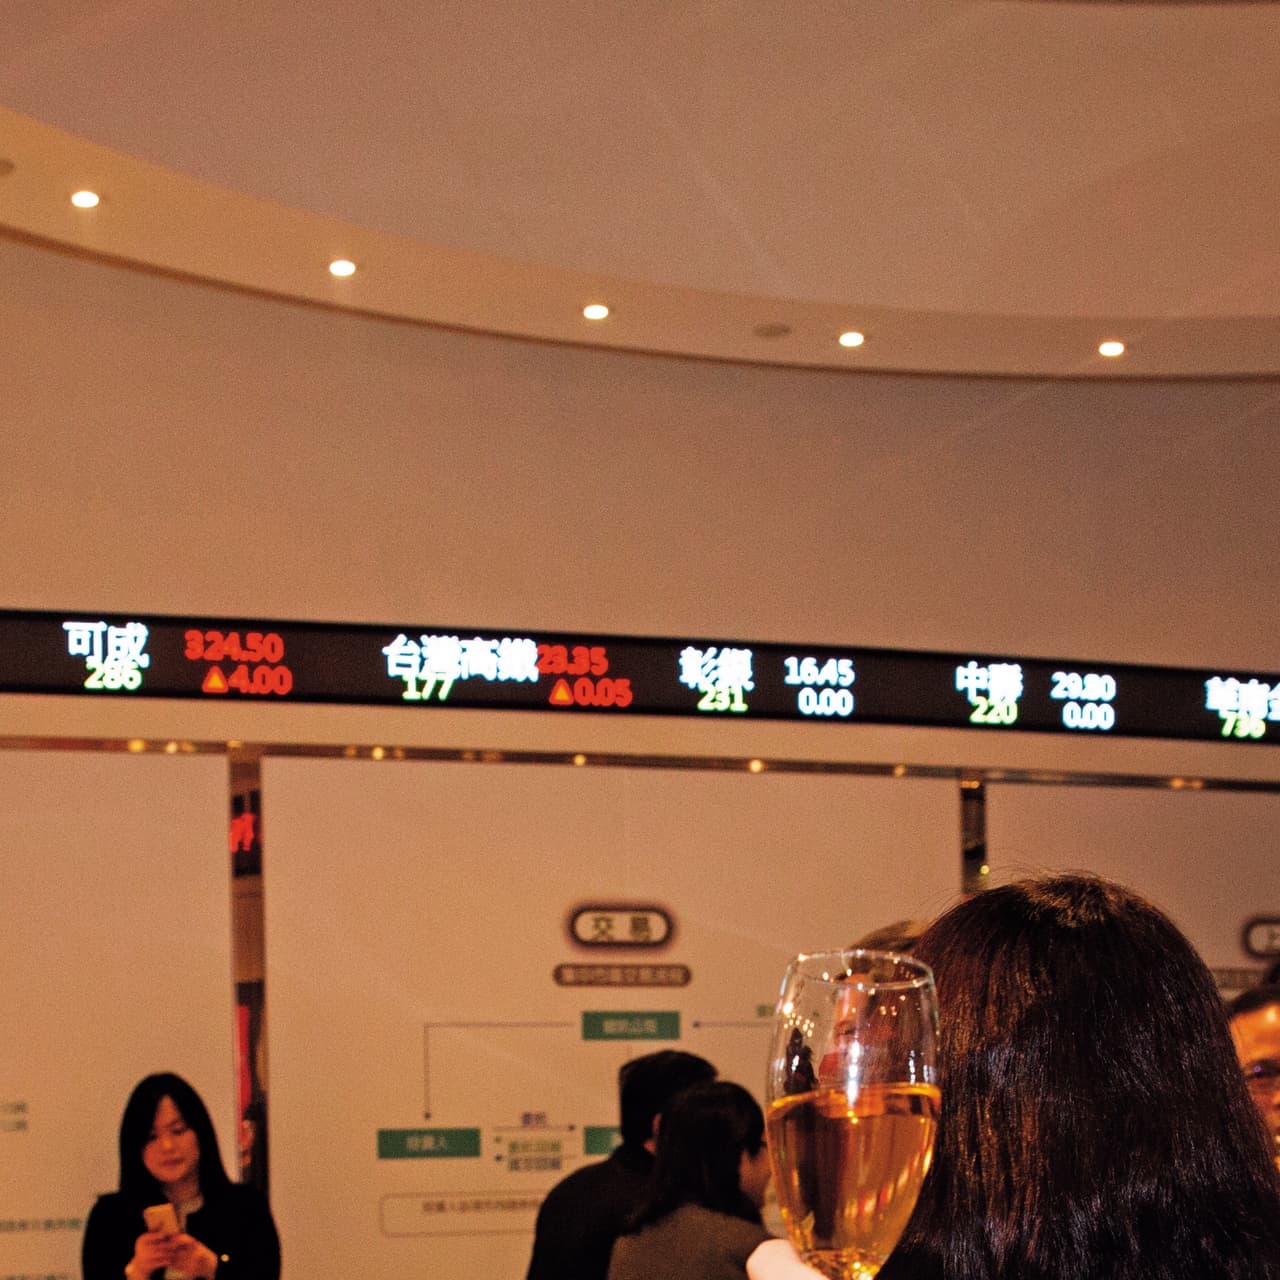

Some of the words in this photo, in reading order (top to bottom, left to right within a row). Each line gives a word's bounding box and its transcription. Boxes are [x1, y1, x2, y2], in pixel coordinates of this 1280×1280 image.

[184, 629, 284, 663] 324.50
[227, 664, 293, 695] 4.00
[784, 656, 855, 687] 16.45
[573, 677, 633, 707] 0.05
[797, 687, 854, 717] 0.00
[1062, 701, 1115, 730] 0.00
